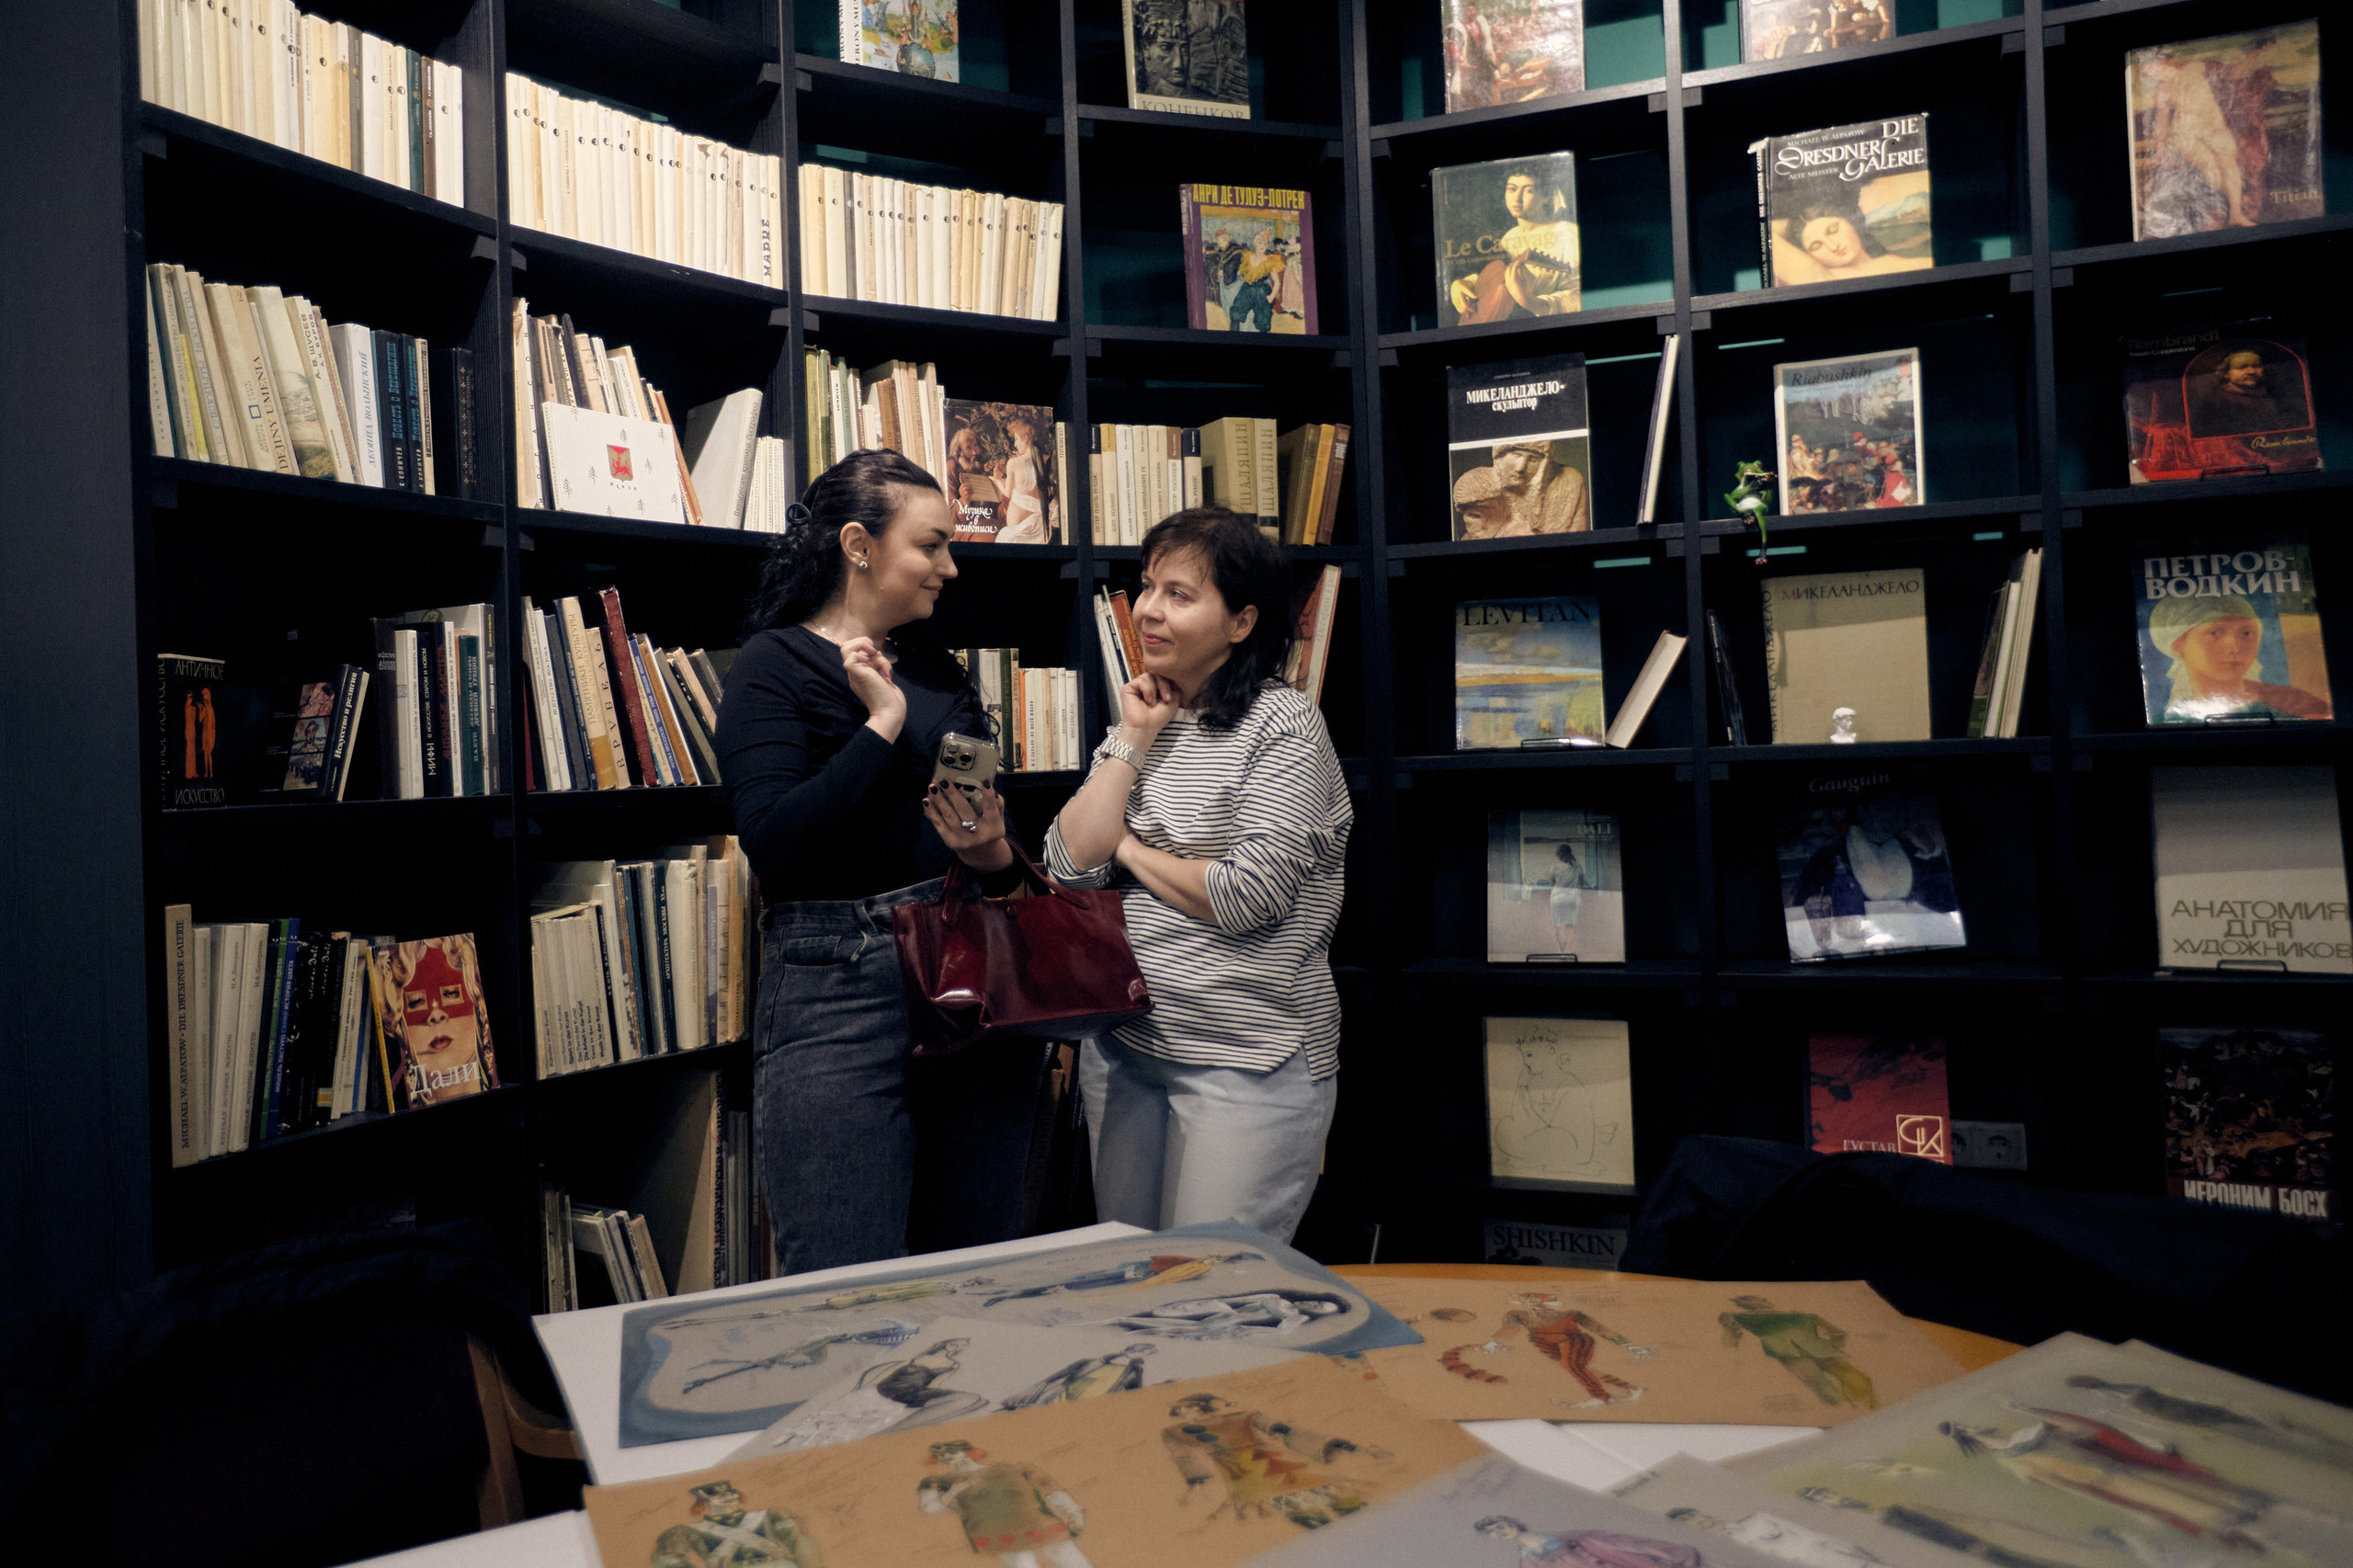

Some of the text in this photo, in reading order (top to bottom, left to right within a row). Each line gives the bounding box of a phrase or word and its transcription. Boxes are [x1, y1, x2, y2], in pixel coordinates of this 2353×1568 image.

[1787, 137, 1820, 147] MICHAEL
[1830, 129, 1865, 141] ALPATOW
[1881, 118, 1919, 139] DIE
[1775, 140, 1884, 175] DRESDNER
[1807, 167, 1838, 178] MEISTER
[1839, 137, 1925, 181] GALERIE
[1193, 184, 1305, 210] АНРИ ДЕ ТУЛУЗ-ЛОТРЕК
[762, 219, 771, 277] МАРКЕ
[1443, 239, 1471, 258] Le
[184, 291, 203, 354] ИСКУССТВА
[301, 313, 315, 357] ЩУСЕВ
[309, 313, 320, 348] БУРОВ
[2128, 329, 2222, 350] Rembrandt
[386, 341, 400, 394] ВЕРЕЩАГИНЕ
[1792, 367, 1872, 387] Riabushkin
[1466, 381, 1566, 404] МИКЕЛАНДЖЕЛО-
[1492, 397, 1538, 414] скульптор
[253, 357, 288, 470] DEJINY UMENIA
[358, 350, 377, 468] ЛЕОНИД ВОЛЫНСКИЙ
[391, 404, 404, 440] ПОВЕСТЬ
[412, 405, 422, 441] ПОВЕСТЬ
[734, 402, 758, 517] Пятьдесят кратких биографий
[1235, 423, 1253, 506] ШАЛЯПИН
[1261, 428, 1276, 512] ШАЛЯПИН
[2143, 551, 2295, 579] ПЕТРОВ-
[1781, 580, 1919, 601] МИКЕЛАНДЖЕЛО
[2144, 571, 2301, 600] ВОДКИН
[1464, 600, 1590, 626] LEVITAN
[175, 659, 224, 681] АНТИЧНОЕ
[569, 613, 596, 723] ПАМЯТНИКИ КУЛЬТУРЫ
[334, 714, 349, 759] Искусство
[346, 672, 358, 709] религия
[595, 642, 626, 768] ВРУБЕЛЬ
[427, 742, 437, 775] МИФЫ
[175, 789, 225, 805] ИСКУССТВО
[1808, 770, 1892, 794] Gauguin
[660, 905, 668, 936] МОСКВЫ
[2171, 900, 2348, 921] АНАТОМИЯ
[176, 920, 185, 958] GALERIE
[2223, 919, 2293, 939] ДЛЯ
[662, 937, 672, 980] АРХИТЕКТУРА
[2174, 938, 2353, 959] ХУДОЖНИКОВ
[177, 960, 187, 1011] DRESDNER
[284, 980, 292, 1010] ИСТОРИЯ
[411, 1062, 483, 1101] Дали
[182, 1099, 190, 1149] MICHAEL
[2184, 1180, 2271, 1210] ИЕРОНИМ
[2278, 1187, 2327, 1218] БОСХ
[1493, 1224, 1615, 1256] SHISHKIN
